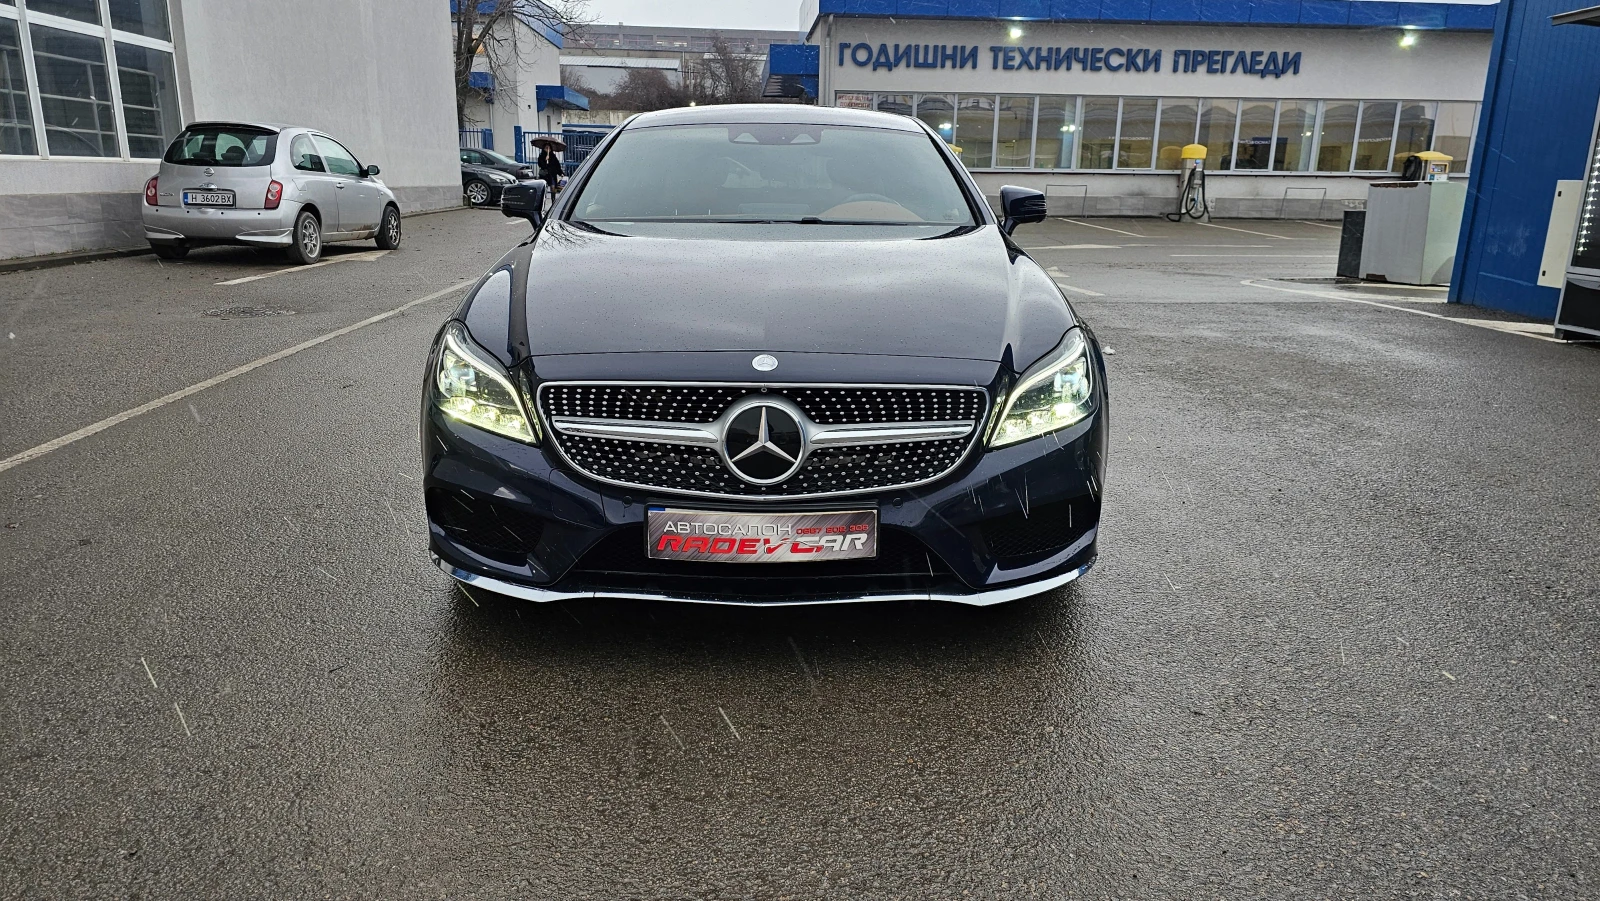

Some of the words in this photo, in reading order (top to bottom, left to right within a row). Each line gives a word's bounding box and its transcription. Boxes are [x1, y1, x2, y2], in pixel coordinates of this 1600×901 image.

[838, 42, 979, 71] ГОДИШНИ
[989, 45, 1162, 72] ТЕХНИЧЕСКИ
[1172, 49, 1301, 78] ПРЕГЛЕДИ
[200, 195, 220, 203] 3602
[663, 521, 792, 536] АВТОСАЛОН
